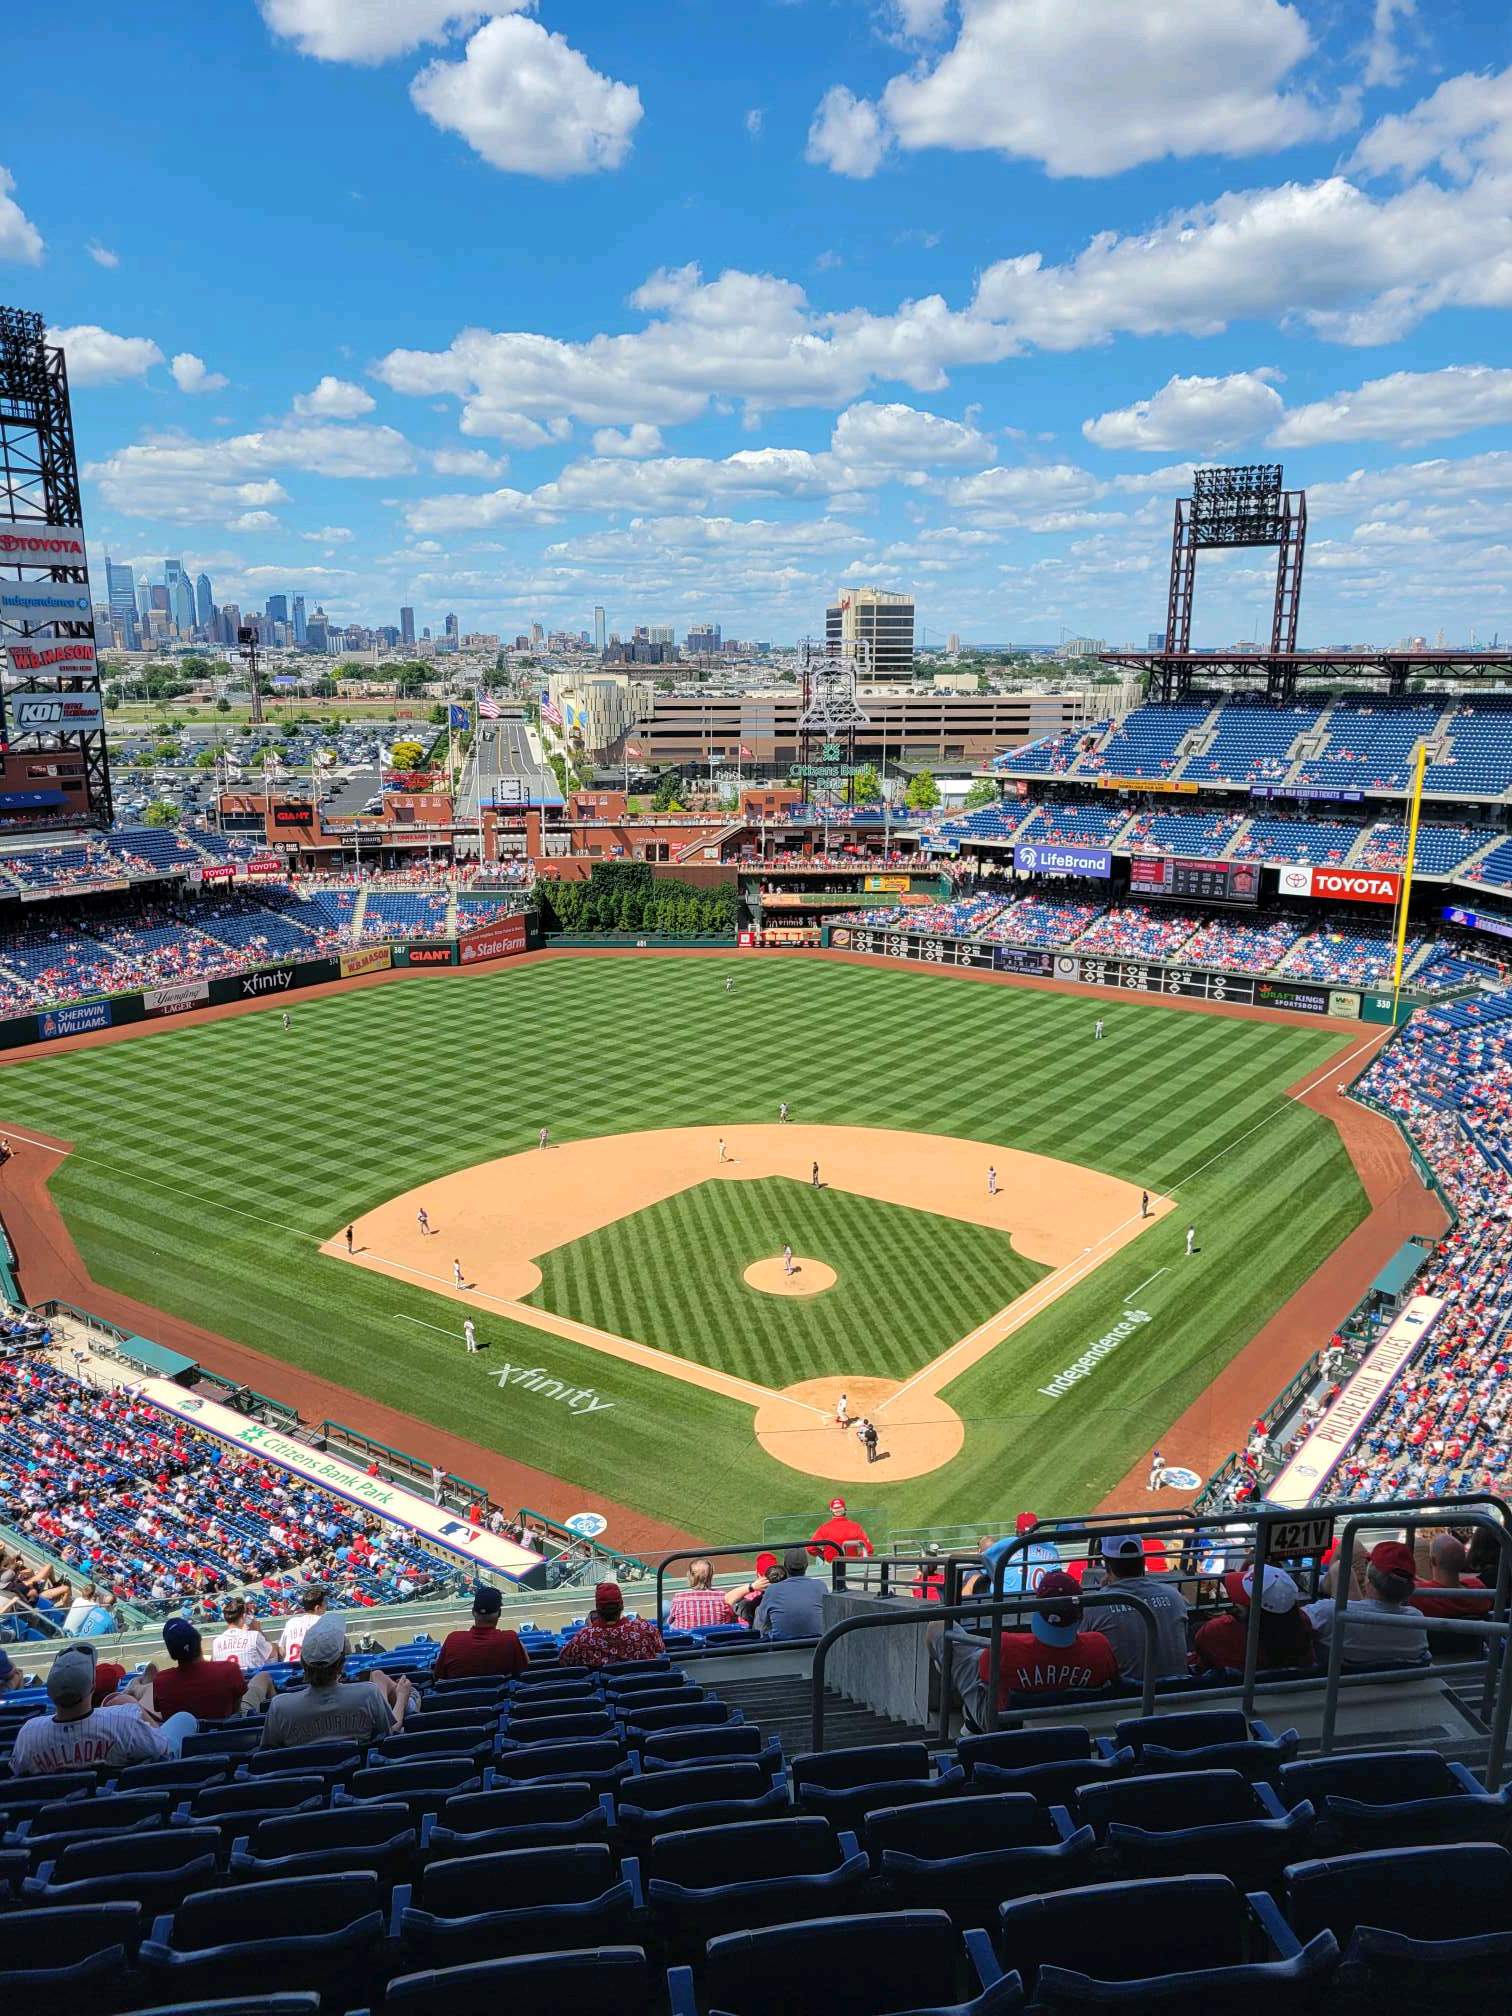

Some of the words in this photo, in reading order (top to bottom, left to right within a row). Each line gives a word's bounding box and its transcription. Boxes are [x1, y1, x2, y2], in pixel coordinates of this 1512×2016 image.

[17, 537, 82, 554] TOYOTA
[2, 595, 76, 608] Independence
[20, 704, 62, 721] KDI
[790, 764, 839, 776] Citizens
[841, 763, 871, 776] Bank
[816, 778, 843, 789] Park
[278, 812, 310, 820] GIANT
[249, 862, 278, 871] TOYOTA
[1041, 853, 1106, 870] LifeBrand
[205, 868, 234, 877] TOYOTA
[1316, 875, 1394, 896] TOYOTA
[410, 950, 451, 960] GIANT
[243, 971, 292, 995] xfinity
[163, 1002, 192, 1014] LAGER
[1275, 999, 1323, 1011] SPORTSBOOK
[1376, 1000, 1390, 1008] 330
[58, 1005, 104, 1022] SHERWIN
[1037, 1322, 1136, 1398] Independence
[488, 1363, 616, 1415] xfinity
[1317, 1375, 1385, 1444] PHILADELPHIA
[1367, 1336, 1412, 1374] PHILLIES
[263, 1438, 317, 1469] Citizens
[318, 1464, 360, 1487] Bank
[356, 1481, 394, 1504] Park
[1275, 1521, 1326, 1549] 421V
[1017, 1664, 1092, 1688] HARPER
[33, 1739, 116, 1771] HALLADAY
